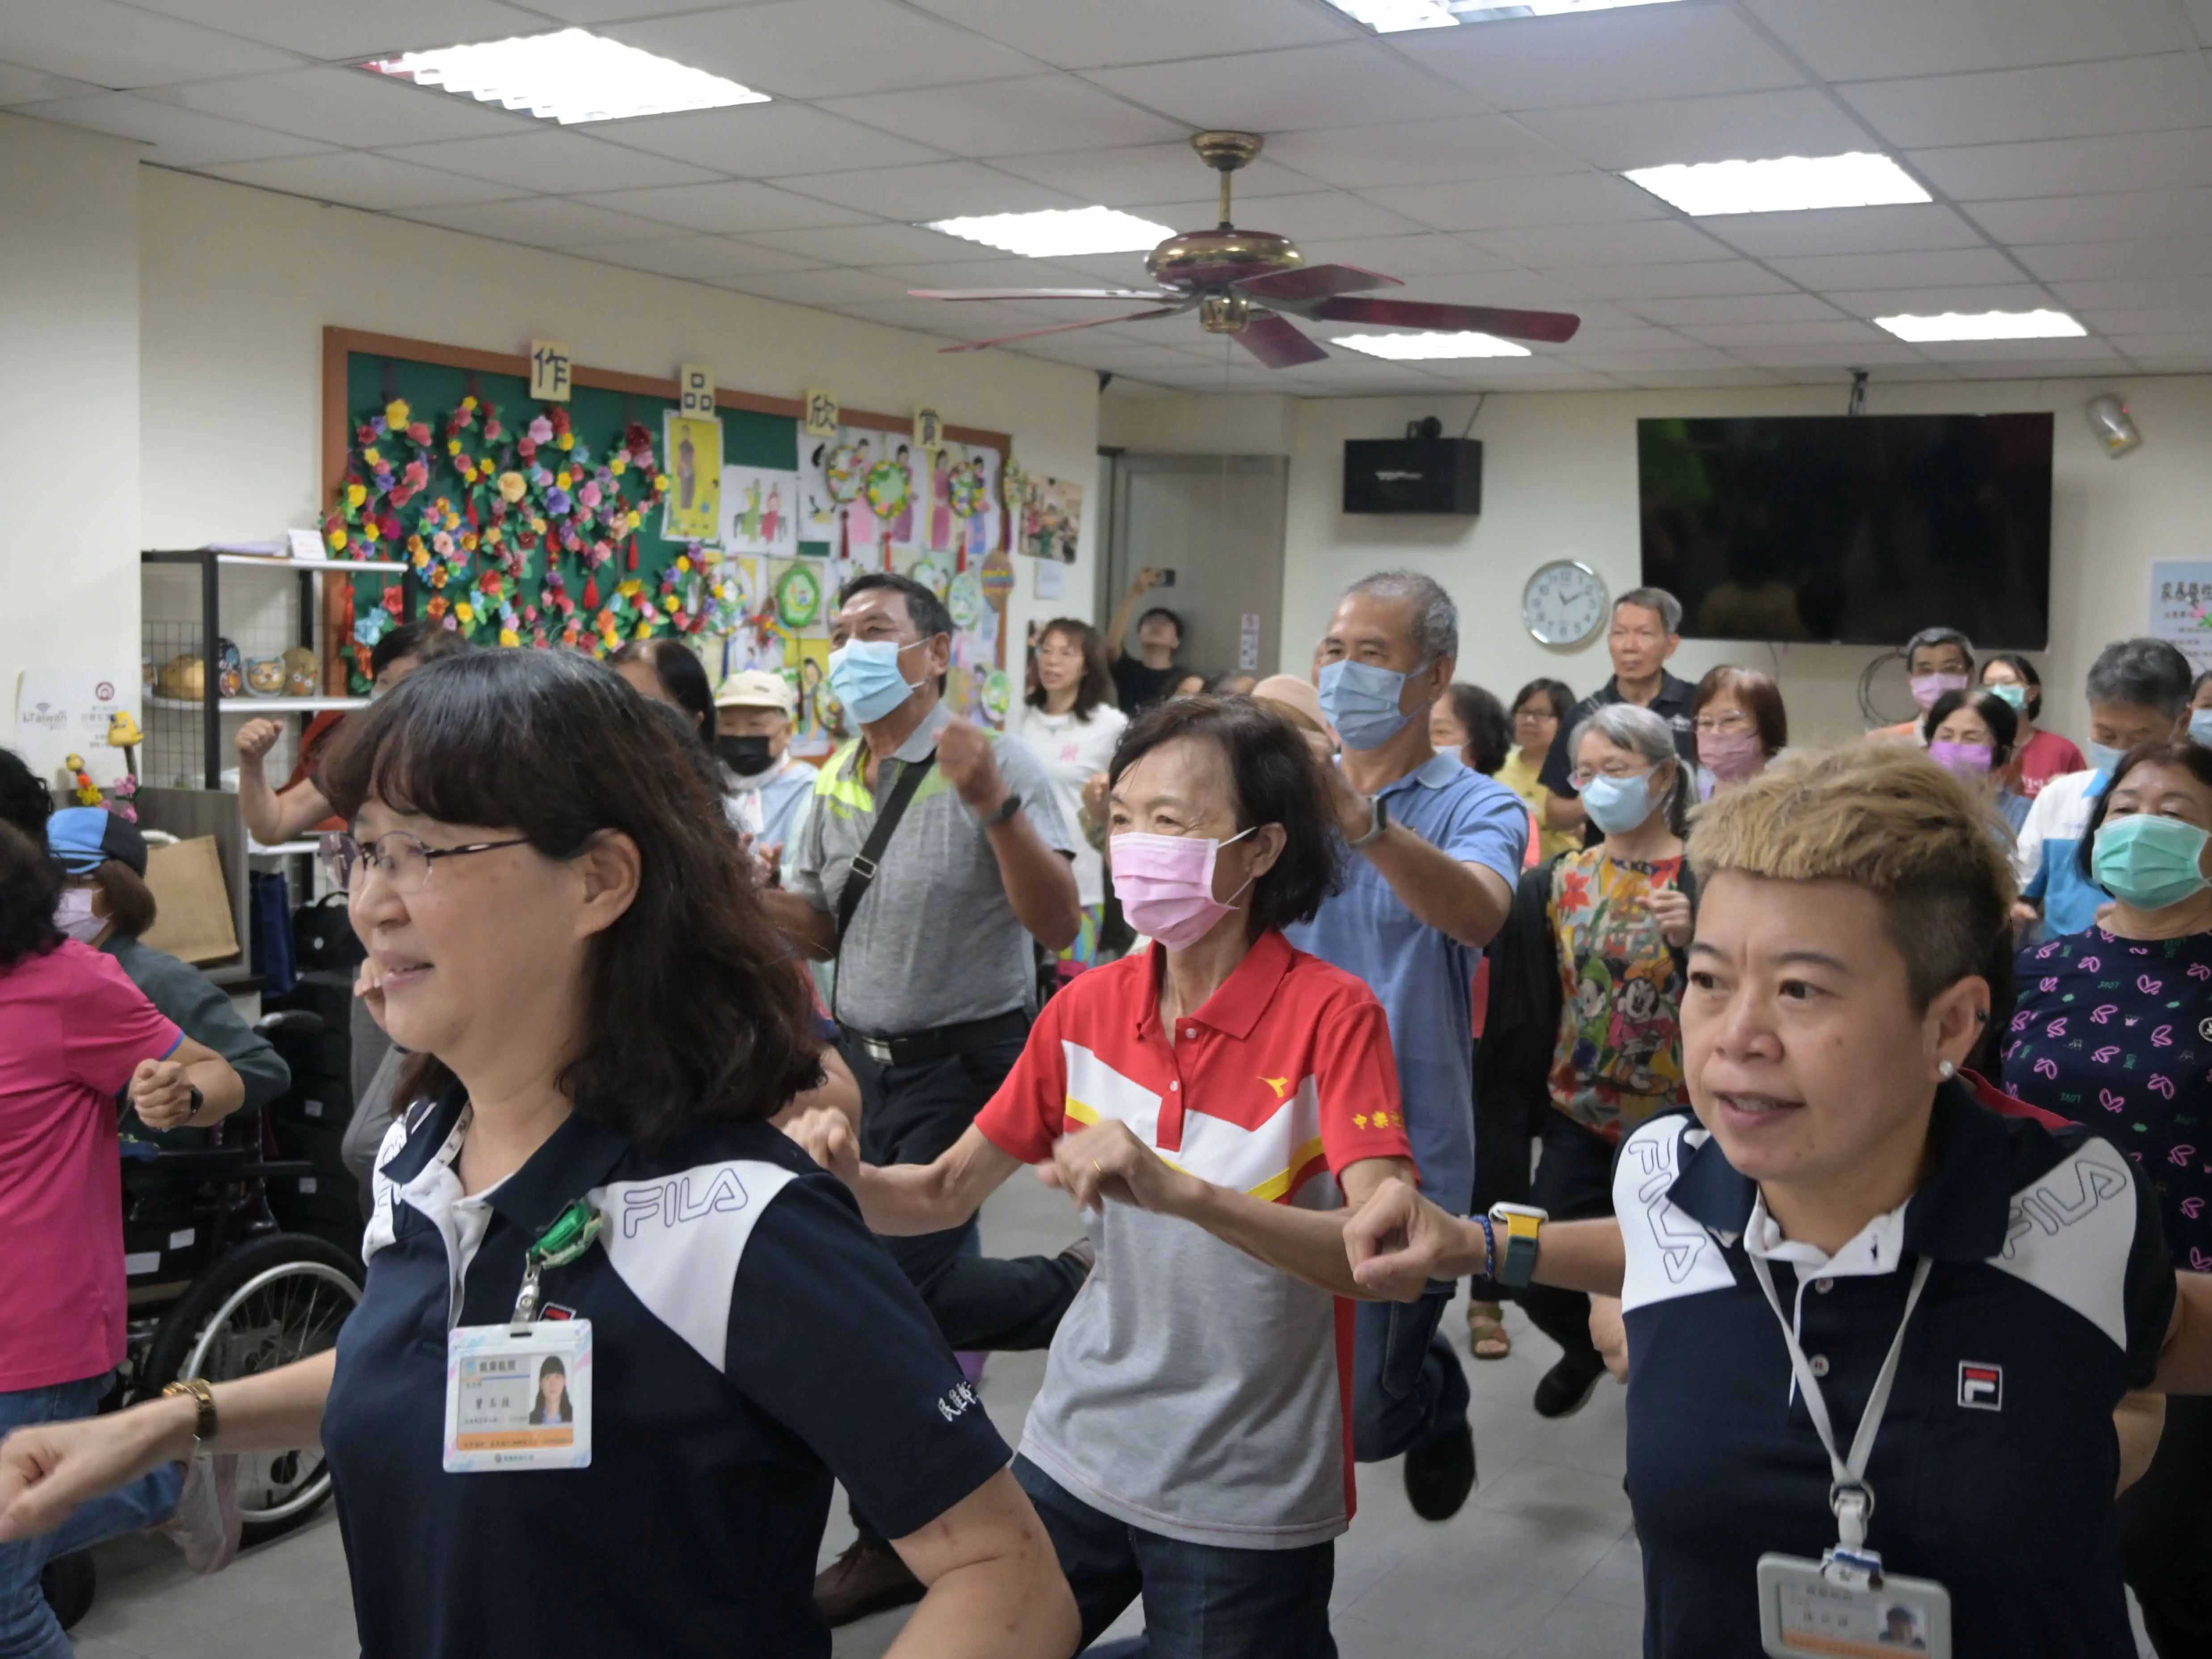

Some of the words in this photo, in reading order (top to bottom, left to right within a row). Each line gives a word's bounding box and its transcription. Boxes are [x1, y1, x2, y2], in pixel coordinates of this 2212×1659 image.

[534, 347, 568, 392] 作
[684, 372, 713, 411] 品
[810, 394, 837, 431] 欣
[624, 1168, 748, 1238] FILA
[1628, 1136, 1707, 1284] FILA
